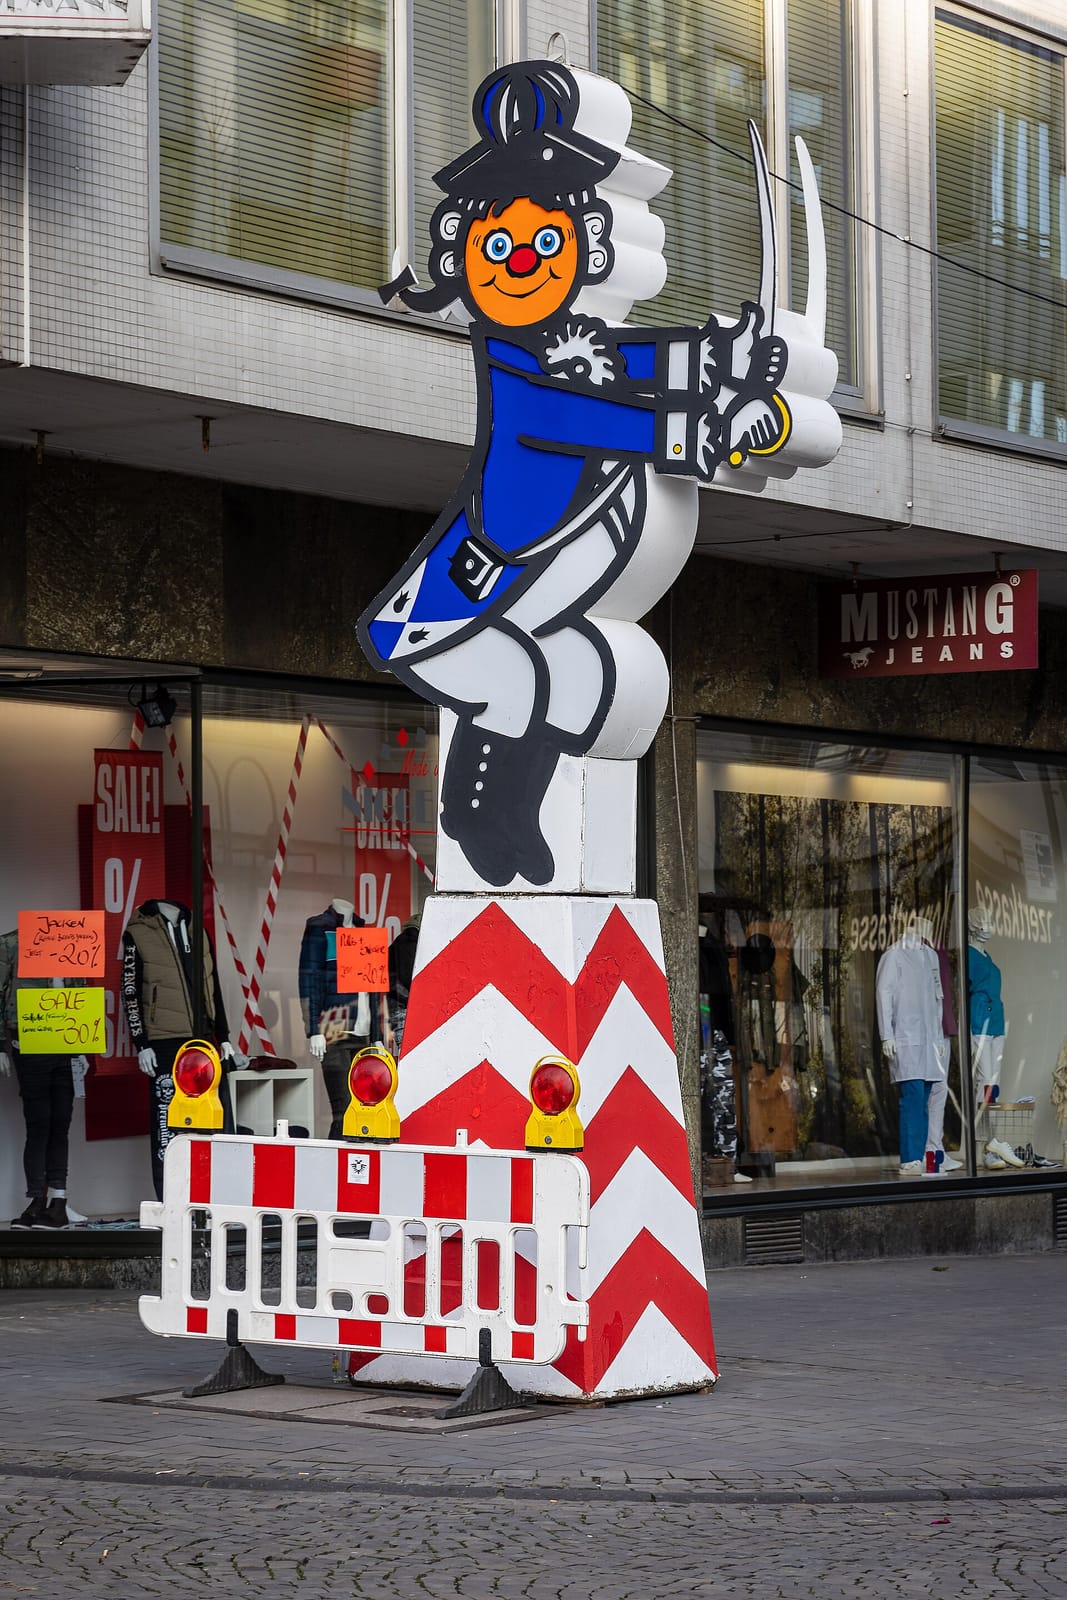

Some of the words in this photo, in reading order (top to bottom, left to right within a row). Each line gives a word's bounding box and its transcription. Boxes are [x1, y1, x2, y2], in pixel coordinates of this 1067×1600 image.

[885, 641, 1014, 665] JEANS
[96, 763, 161, 834] SALE!
[50, 943, 101, 969] -20%
[39, 990, 87, 1011] SALE
[55, 1017, 101, 1045] -30%
